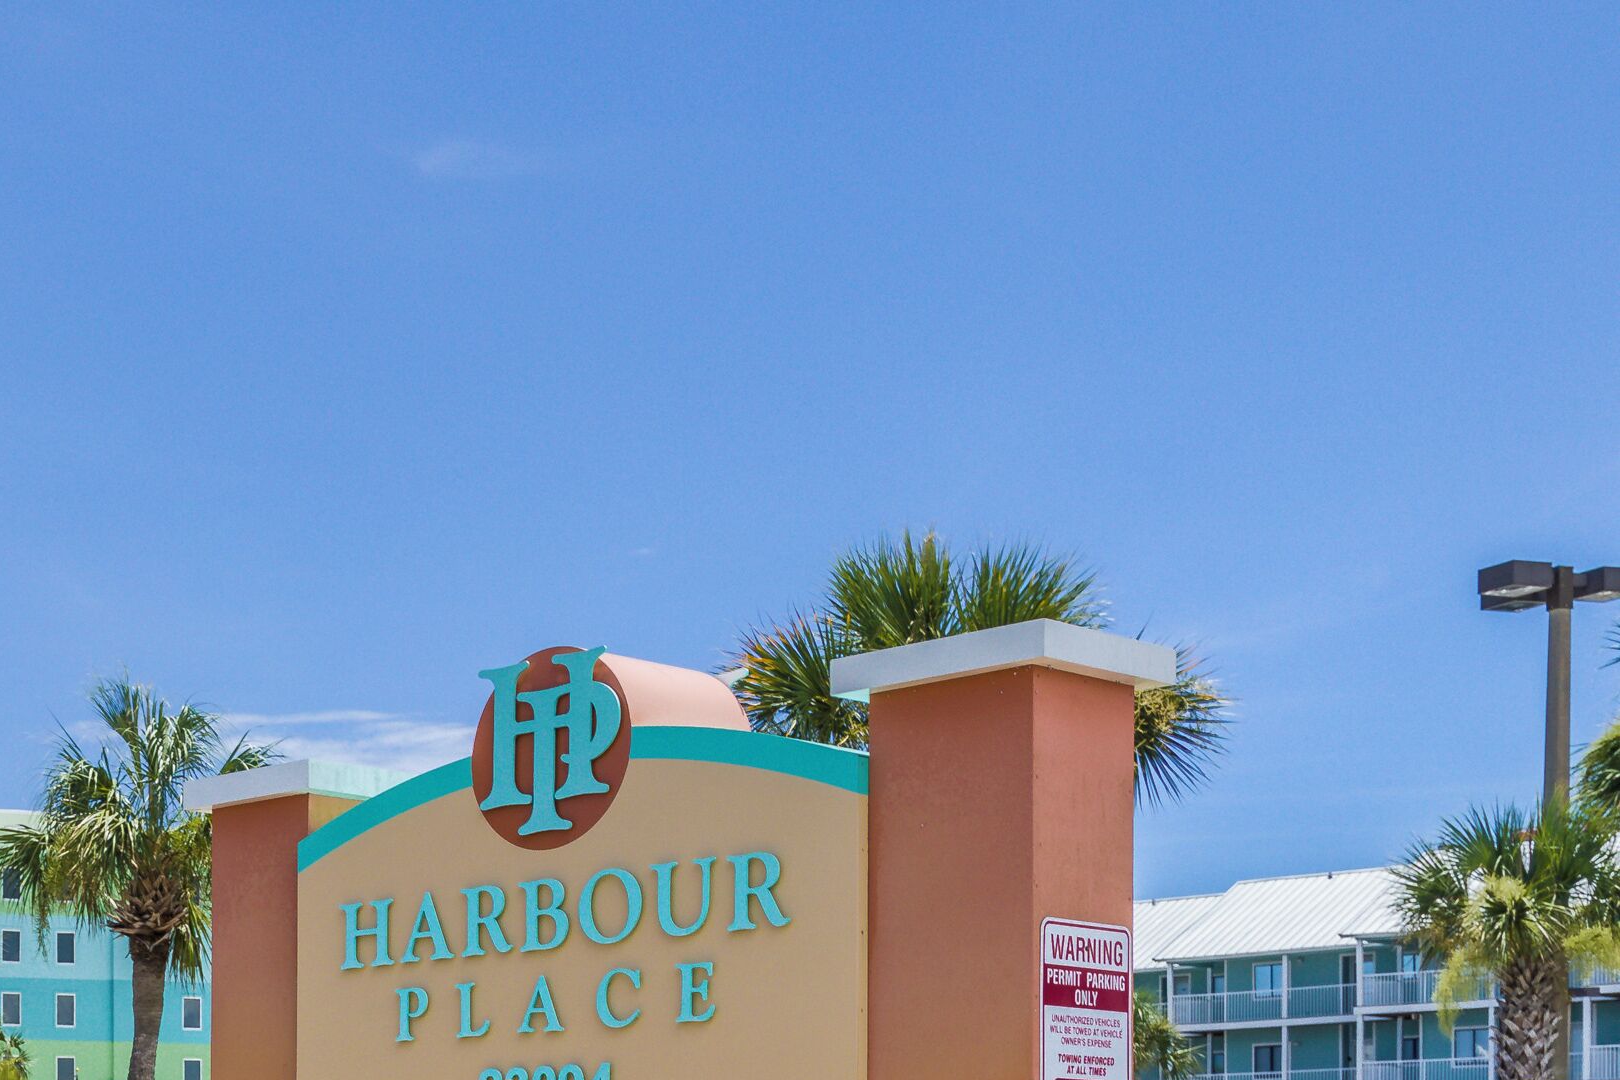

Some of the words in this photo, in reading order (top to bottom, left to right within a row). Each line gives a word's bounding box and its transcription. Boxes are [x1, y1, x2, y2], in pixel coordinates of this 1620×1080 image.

[339, 851, 791, 970] HARBOUR
[1050, 933, 1123, 967] WARNING
[1046, 968, 1081, 987] PERMIT
[1086, 972, 1126, 992] PARKING
[395, 961, 716, 1042] PLACE
[1074, 989, 1098, 1007] ONLY
[1051, 1014, 1093, 1026] UNAUTHORIZED
[1094, 1018, 1121, 1028] VEHICLES
[1050, 1025, 1063, 1034] WILL
[1064, 1026, 1071, 1034] BE
[1073, 1026, 1092, 1036] TOWED
[1093, 1028, 1099, 1036] AT
[1100, 1029, 1123, 1039] VEHICLE
[1061, 1036, 1086, 1047] OWNER'S
[1087, 1038, 1112, 1048] EXPENSE
[1058, 1053, 1082, 1064] TOWING
[1083, 1055, 1115, 1066] ENFORCED
[1066, 1065, 1074, 1074] AT
[1076, 1066, 1087, 1075] ALL
[1088, 1067, 1107, 1077] TIMES
